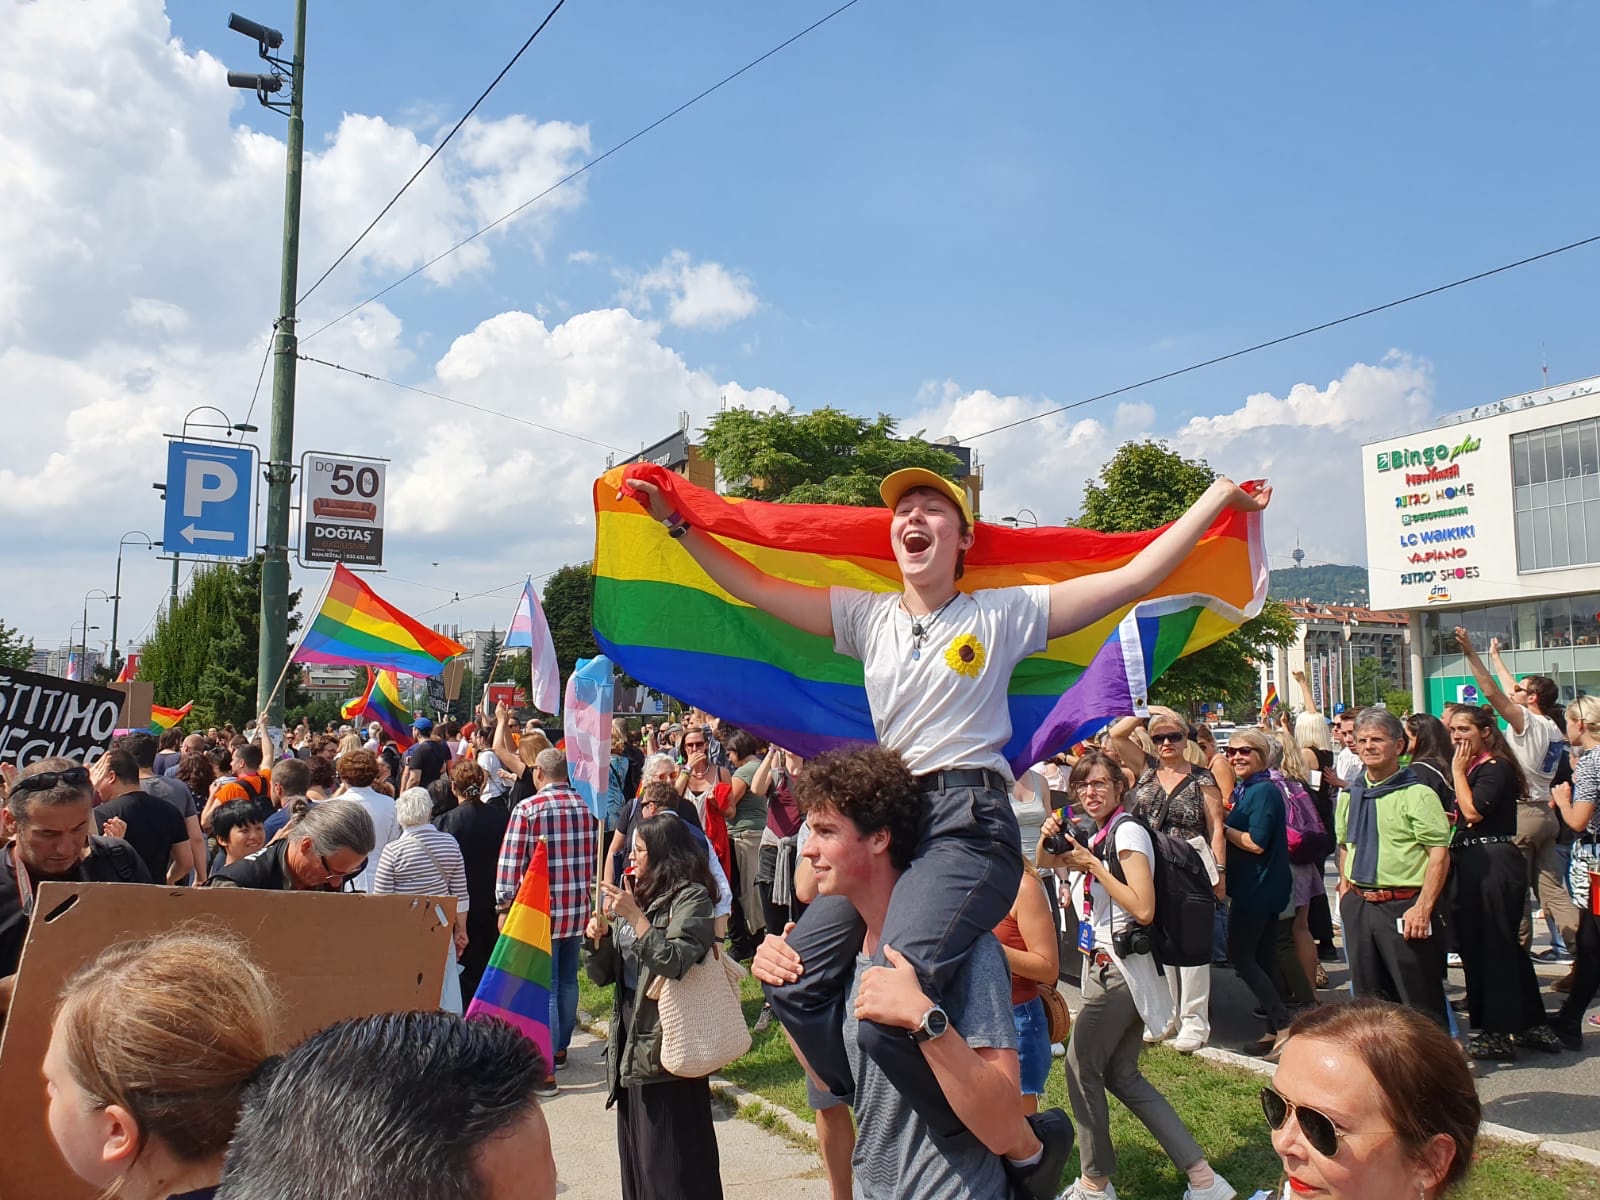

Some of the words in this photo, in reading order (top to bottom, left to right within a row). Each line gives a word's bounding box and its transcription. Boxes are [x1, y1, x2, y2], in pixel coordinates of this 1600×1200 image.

[1391, 445, 1449, 469] Bingo
[1449, 434, 1481, 463] plus
[183, 459, 239, 517] P
[316, 461, 334, 473] DO
[331, 464, 379, 498] 50
[1436, 483, 1475, 500] HOME
[315, 526, 371, 543] DOĞTAŞ
[1400, 530, 1418, 547] LC
[1440, 566, 1480, 581] SHOES
[1430, 584, 1448, 595] dm
